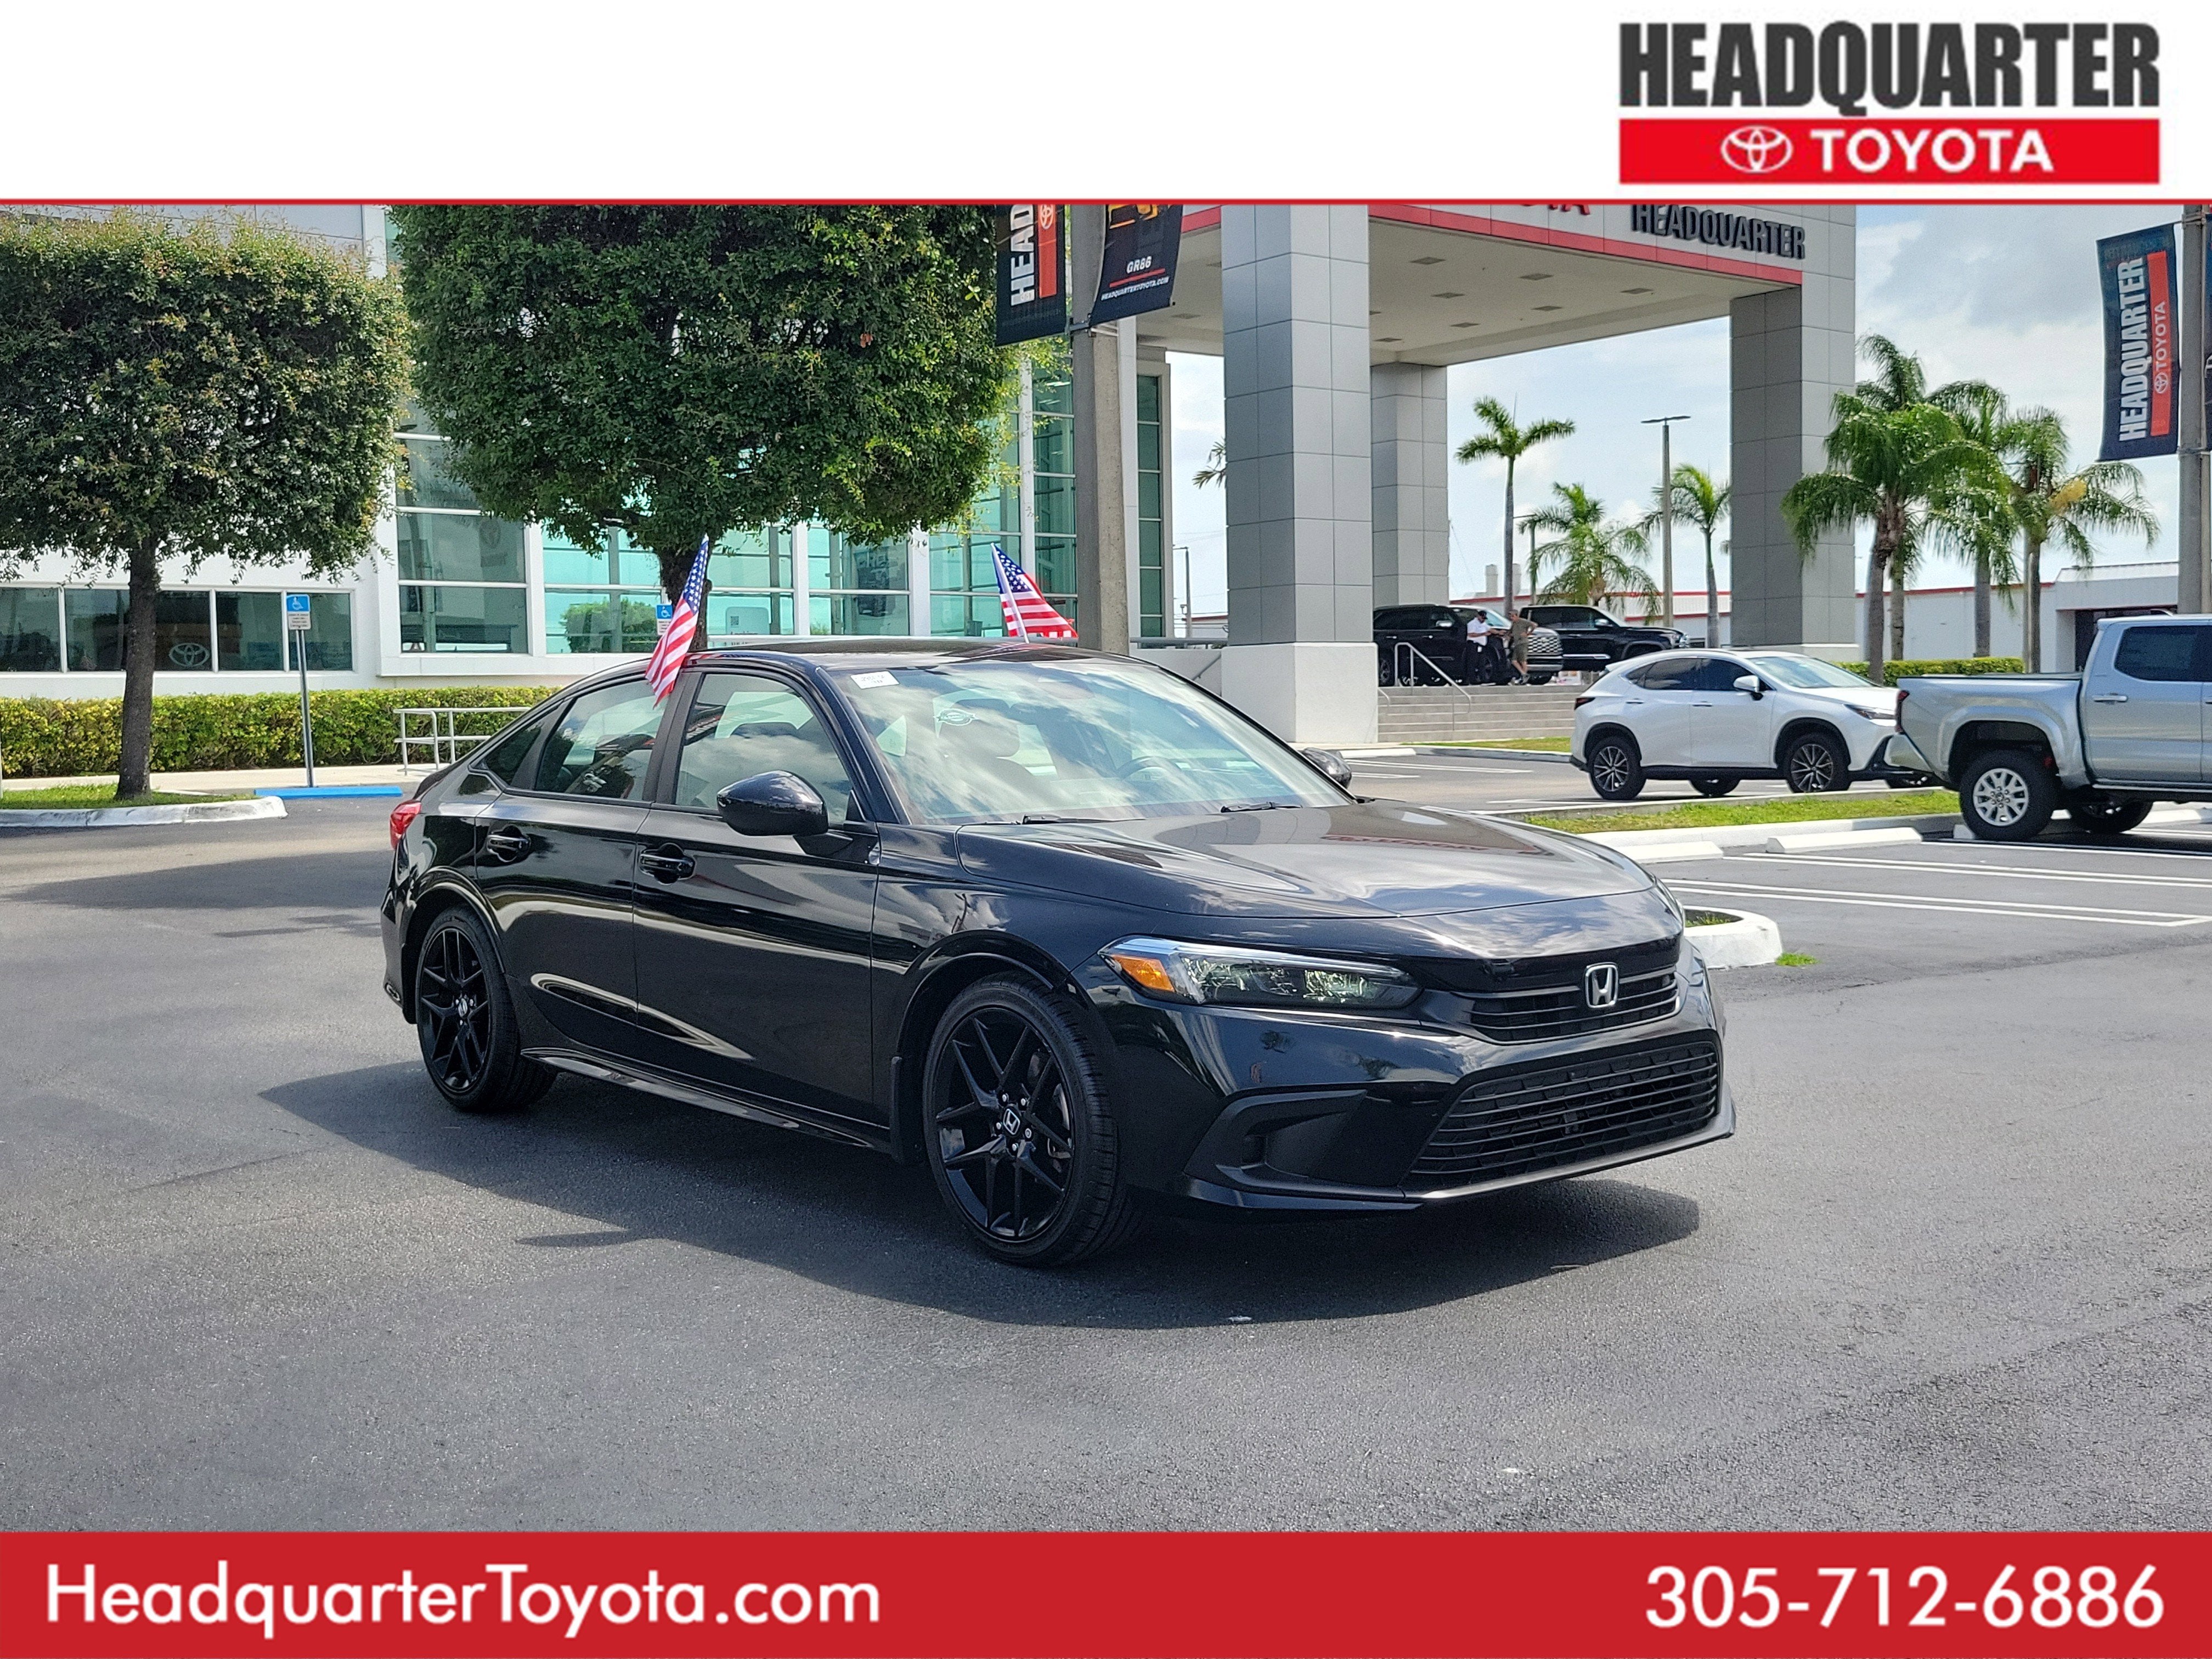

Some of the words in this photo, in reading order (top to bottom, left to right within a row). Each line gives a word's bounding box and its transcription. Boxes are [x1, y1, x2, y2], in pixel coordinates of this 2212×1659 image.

[1630, 204, 1805, 259] HEADQUARTER
[1126, 256, 1152, 274] GR86
[2117, 257, 2152, 442] HEADQUARTER
[2154, 301, 2168, 371] TOYOTA
